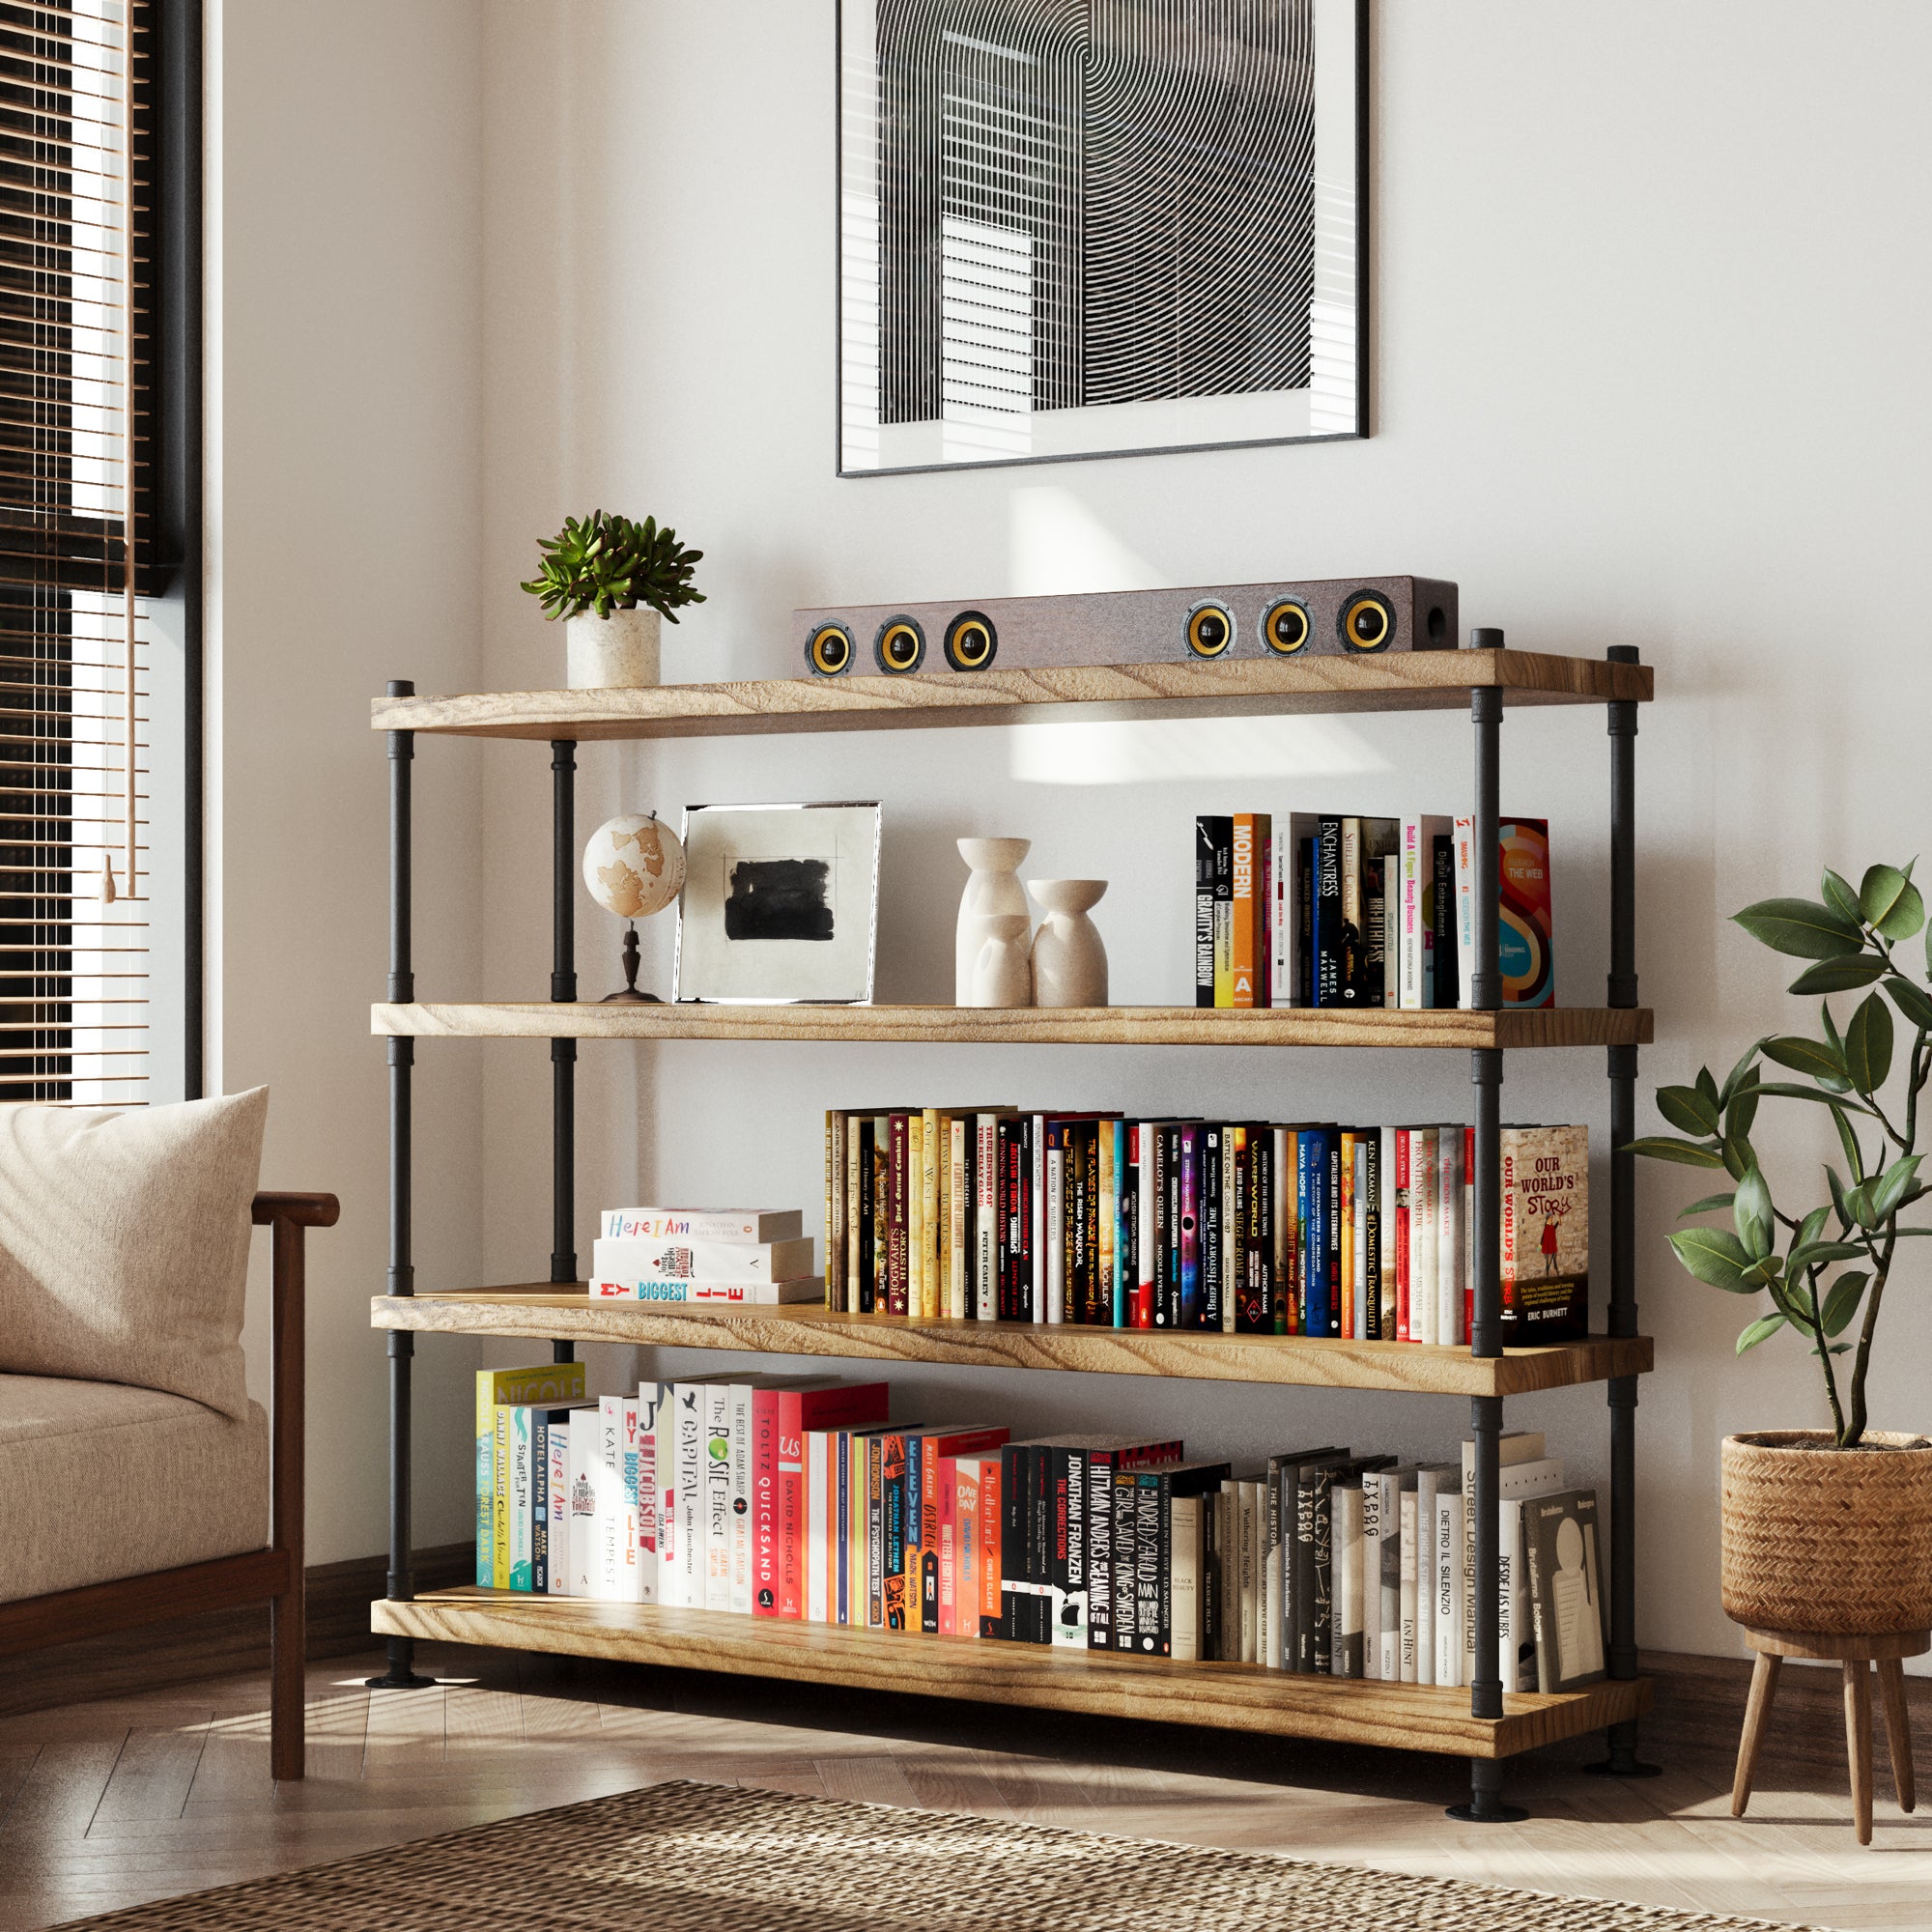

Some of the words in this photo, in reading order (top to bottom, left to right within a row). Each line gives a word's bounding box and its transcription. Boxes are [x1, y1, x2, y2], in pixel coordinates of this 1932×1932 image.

[1345, 833, 1355, 866] SHIELD
[1406, 825, 1415, 842] Build
[1234, 825, 1251, 898] MODERN
[1322, 822, 1338, 896] ENCHANTRESS
[1406, 857, 1415, 879] Figure
[1436, 851, 1447, 878] Digital
[1509, 867, 1524, 879] THE
[1526, 868, 1544, 880] WEB
[1406, 880, 1415, 904] Beauty
[1198, 895, 1212, 941] GRAVITY'S
[1406, 905, 1415, 933] Business
[1436, 882, 1447, 937] Entanglement
[1198, 944, 1212, 986] RAINBOW
[849, 1159, 858, 1175] The
[1009, 1142, 1018, 1179] HISTORY
[1504, 1156, 1514, 1189] OUR
[1535, 1157, 1560, 1173] OUR
[849, 1181, 858, 1204] Epic
[986, 1193, 993, 1208] OF
[1009, 1182, 1018, 1212] WORLD
[1520, 1175, 1575, 1194] WORLD'S
[610, 1214, 651, 1237] Here
[651, 1220, 664, 1237] I
[665, 1218, 690, 1236] Am
[849, 1207, 858, 1234] Cycle
[1208, 1207, 1217, 1228] TIME
[1504, 1192, 1514, 1262] WORLD'S
[1009, 1216, 1018, 1254] SPINNING
[1208, 1230, 1217, 1242] OF
[1368, 1222, 1378, 1271] DOMESTIC
[891, 1228, 899, 1295] HOGWARTS
[1208, 1245, 1217, 1283] HISTORY
[601, 1283, 630, 1295] MY
[638, 1281, 688, 1301] BIGGEST
[696, 1288, 744, 1300] LIE
[1208, 1285, 1217, 1311] BRIEF
[1368, 1273, 1378, 1327] TRANQUILITY
[1527, 1311, 1541, 1321] ERIC
[1542, 1307, 1568, 1320] BURNETT
[713, 1397, 725, 1422] The
[735, 1403, 745, 1416] THE
[497, 1410, 505, 1445] DANNY
[626, 1411, 638, 1443] MY
[735, 1418, 745, 1435] BEST
[735, 1436, 745, 1445] OF
[550, 1433, 568, 1479] Here
[606, 1428, 615, 1468] KATE
[682, 1420, 697, 1501] CAPITAL
[735, 1448, 745, 1469] ADAM
[760, 1418, 770, 1470] TOLTZ
[870, 1443, 880, 1460] JON
[497, 1448, 505, 1496] WALLACE
[550, 1480, 568, 1492] I
[624, 1452, 639, 1506] BIGGEST
[735, 1471, 745, 1494] SHARP
[870, 1460, 880, 1500] RONSON
[1056, 1478, 1066, 1495] THE
[1068, 1454, 1082, 1520] JONATHAN
[1090, 1464, 1111, 1513] HITMAN
[550, 1493, 568, 1520] Am
[639, 1452, 656, 1537] JACOBSON
[907, 1440, 919, 1544] ELEVEN
[957, 1485, 978, 1498] ONE
[958, 1498, 978, 1512] DAY
[713, 1490, 726, 1536] Effect
[758, 1476, 771, 1581] QUICKSAND
[871, 1508, 880, 1523] THE
[923, 1503, 937, 1548] OSTRICH
[1056, 1496, 1066, 1560] CORRECTIONS
[1242, 1507, 1251, 1552] Wuthering
[1440, 1509, 1450, 1548] DIETRO
[606, 1516, 615, 1584] TEMPEST
[626, 1515, 636, 1566] LIE
[871, 1524, 880, 1576] PSYCHOPATH
[1090, 1514, 1111, 1558] ANDERS
[909, 1553, 918, 1576] MARK
[1068, 1522, 1082, 1584] FRANZEN
[1440, 1550, 1450, 1561] IL
[871, 1577, 880, 1597] TEST
[1090, 1559, 1110, 1610] MEANING
[1115, 1562, 1134, 1587] KING
[1242, 1555, 1251, 1588] Heights
[909, 1577, 918, 1608] WATSON
[1440, 1564, 1450, 1615] SILENZIO
[1116, 1593, 1135, 1634] SWEDEN
[1404, 1618, 1412, 1635] IAN
[1404, 1637, 1412, 1665] HUNT
